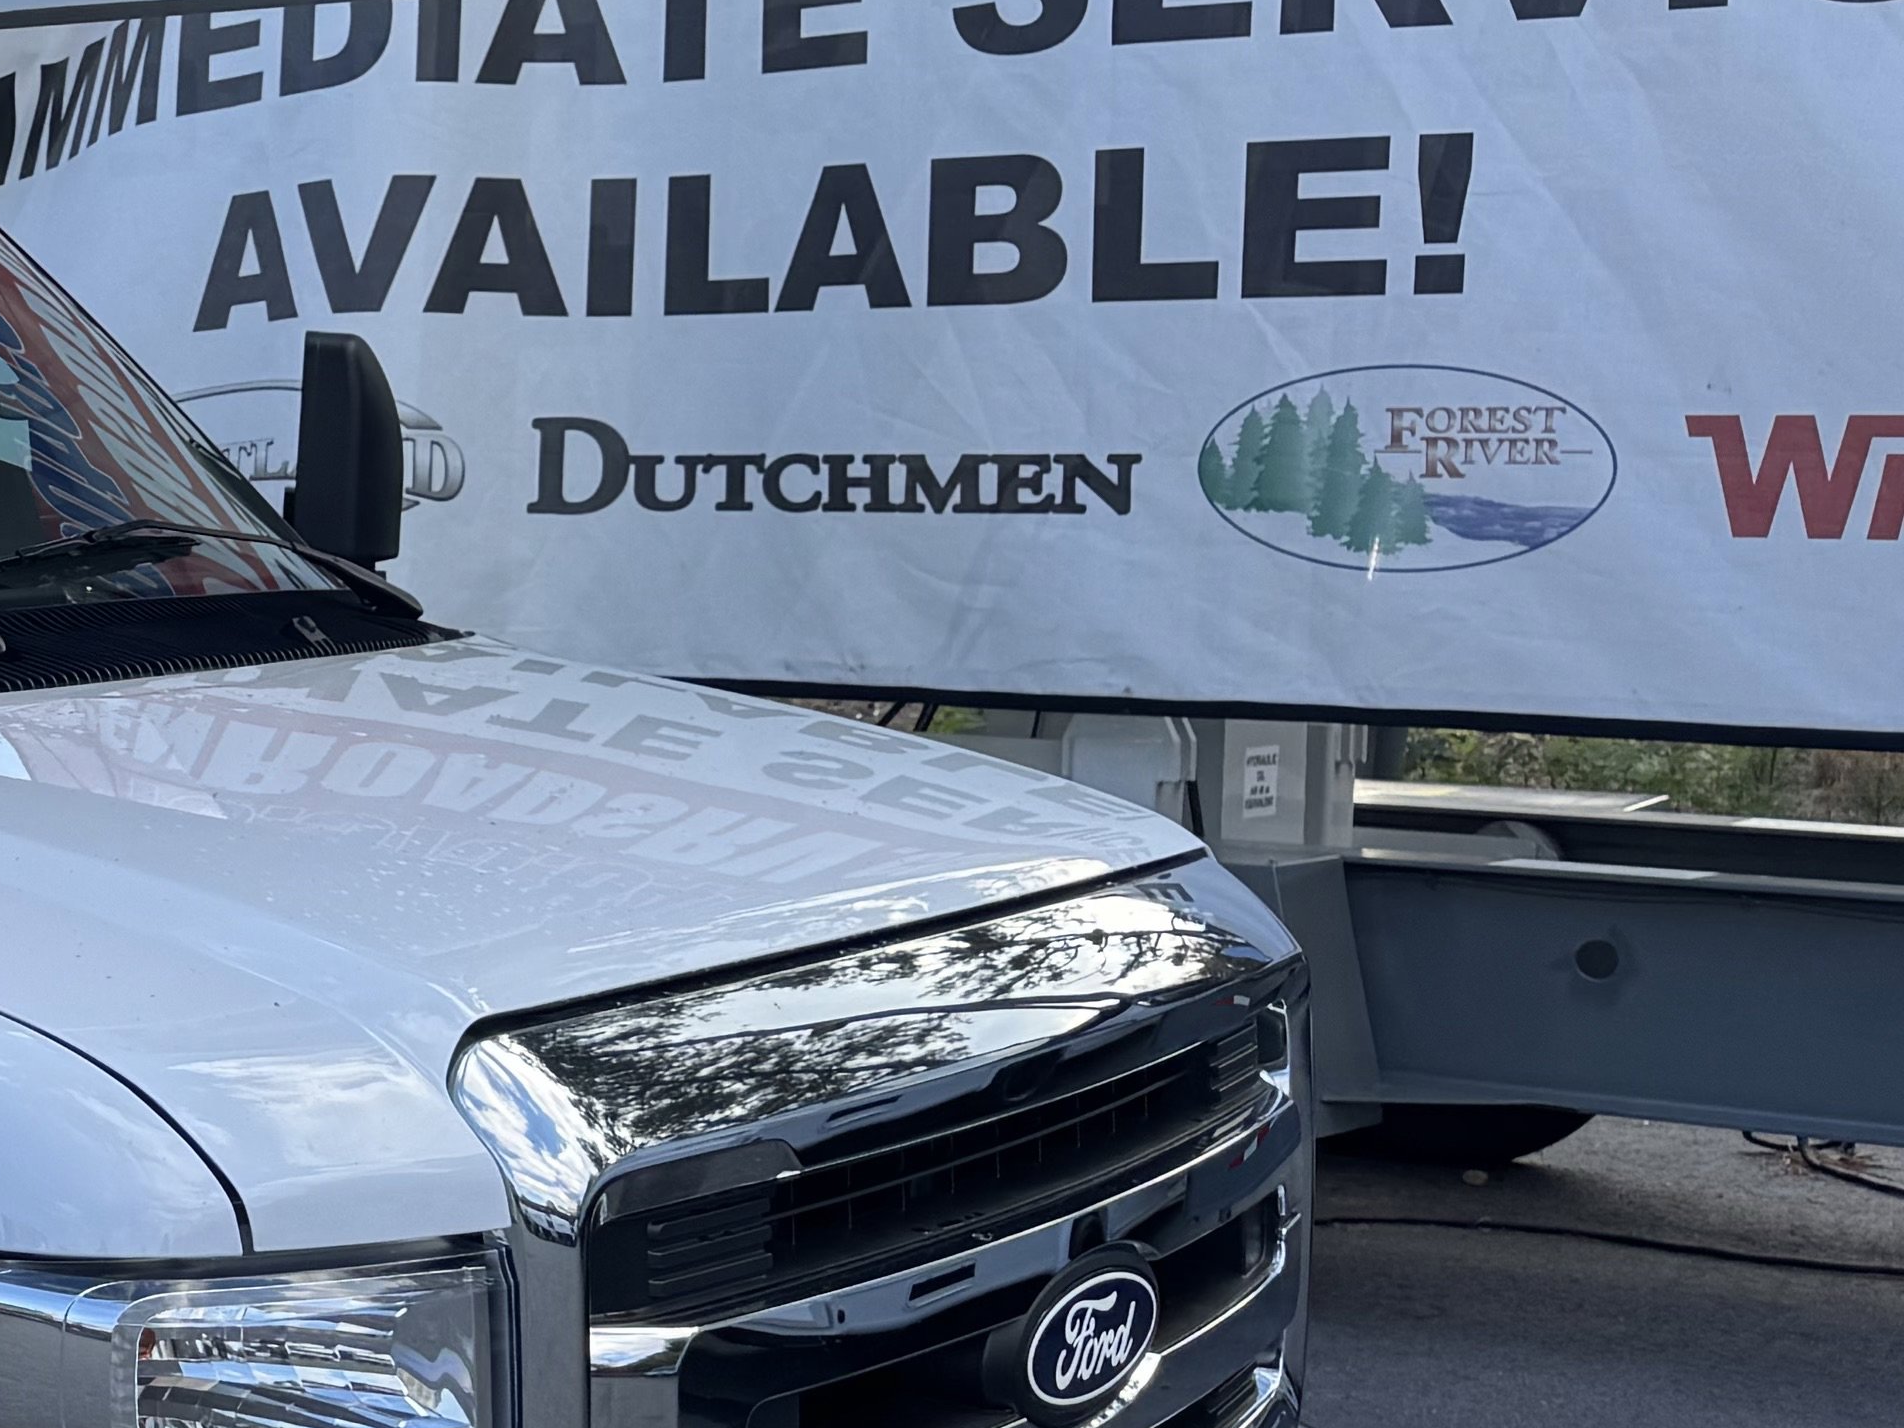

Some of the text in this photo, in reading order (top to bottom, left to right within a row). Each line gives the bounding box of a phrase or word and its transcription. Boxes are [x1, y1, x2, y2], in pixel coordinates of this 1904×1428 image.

[193, 131, 1475, 332] AVAILABLE!
[527, 415, 1141, 515] DUTCHMEN
[1385, 406, 1566, 451] FOREST
[1419, 436, 1561, 478] RIVER
[1056, 1291, 1136, 1390] Ford
